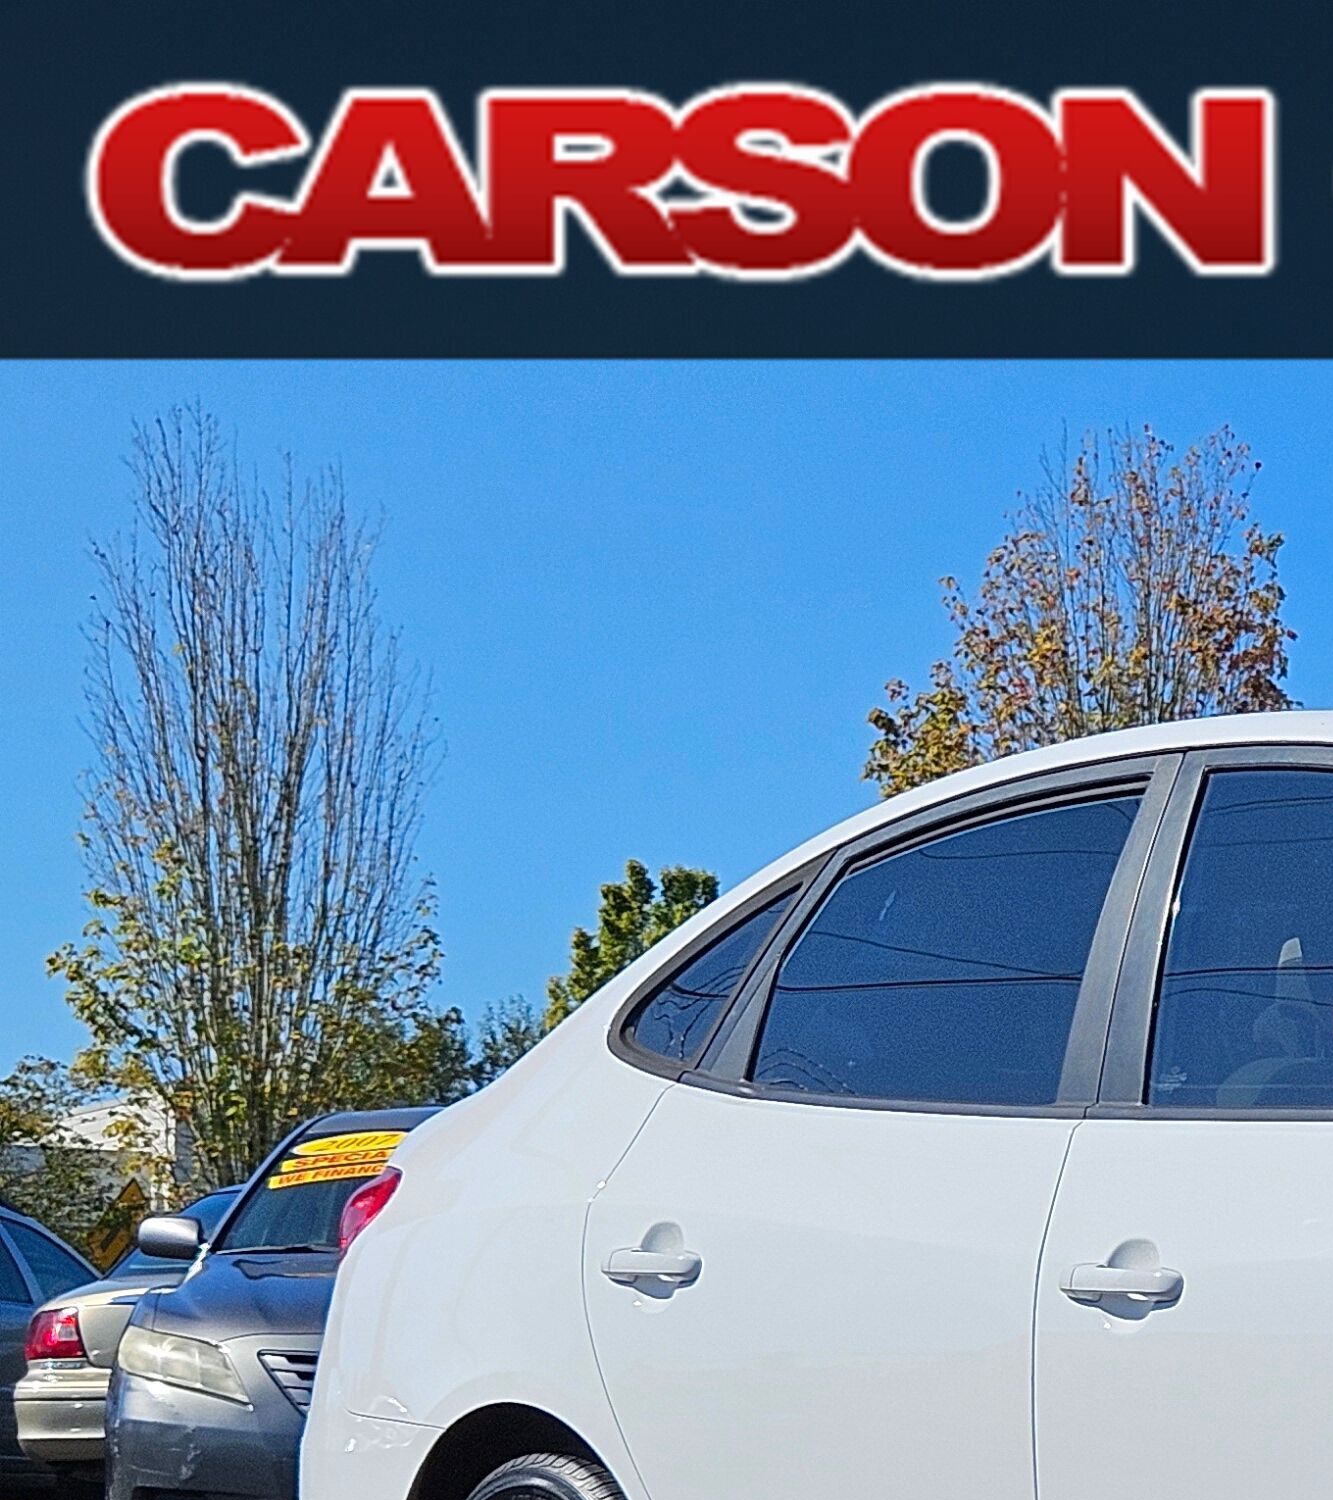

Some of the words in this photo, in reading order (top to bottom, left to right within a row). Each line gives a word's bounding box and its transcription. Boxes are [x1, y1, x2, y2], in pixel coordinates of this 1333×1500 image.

[314, 1134, 401, 1152] 2007
[294, 1151, 388, 1167] SPECIA
[278, 1174, 306, 1185] WE
[312, 1164, 383, 1178] FINANC
